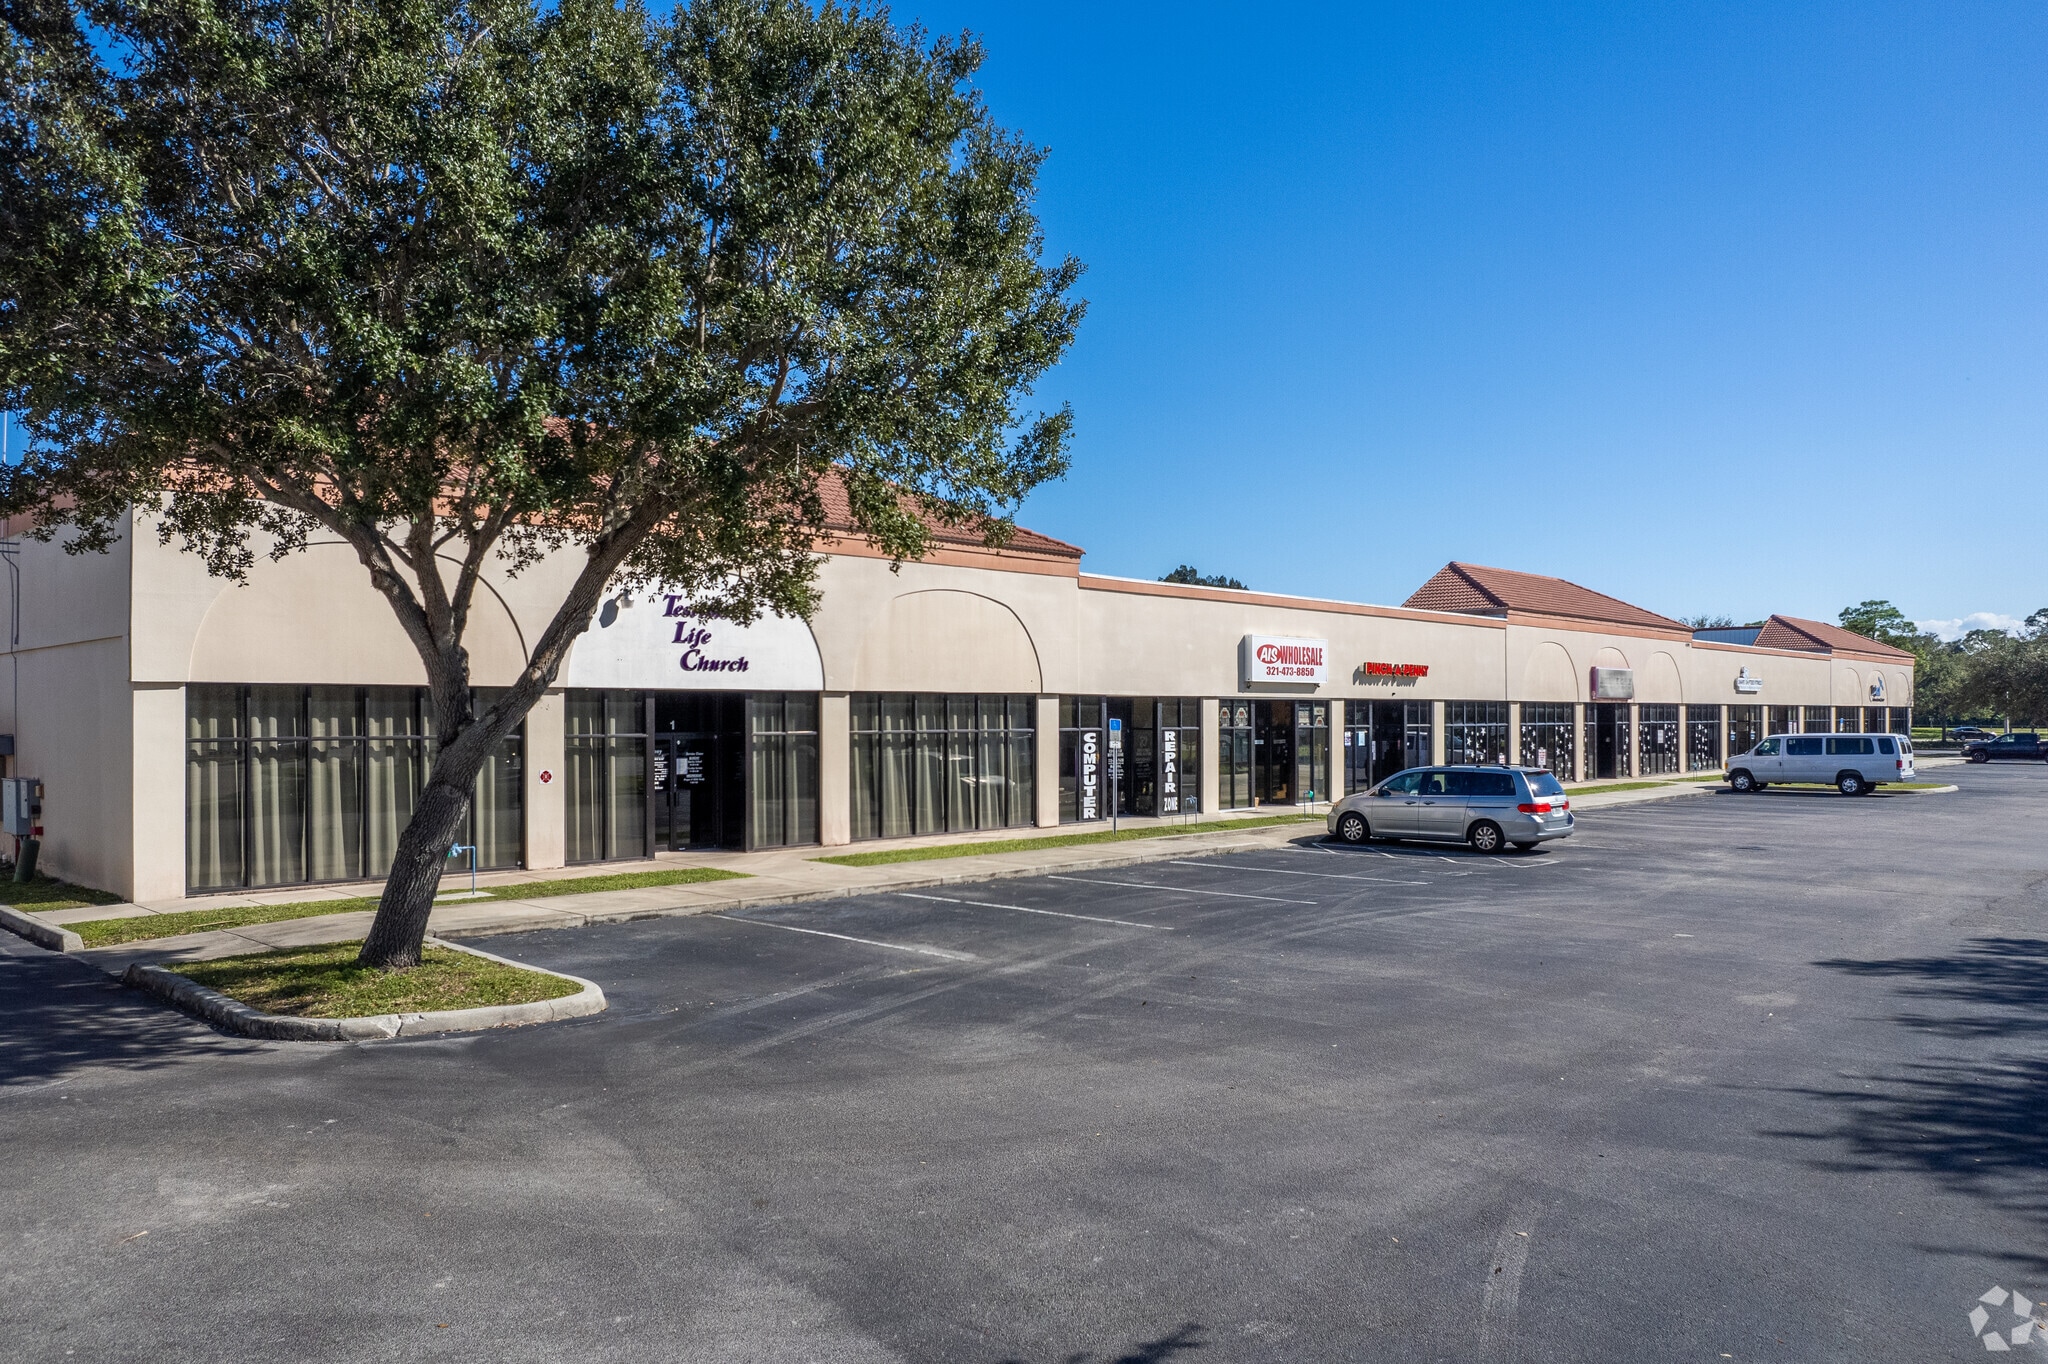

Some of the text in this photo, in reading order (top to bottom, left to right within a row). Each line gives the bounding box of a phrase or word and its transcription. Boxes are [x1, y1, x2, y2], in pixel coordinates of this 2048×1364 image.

[672, 621, 712, 649] Life
[680, 649, 749, 672] Church
[1260, 645, 1323, 666] AIS WHOLESALE
[1266, 666, 1315, 677] 321-473-8850
[670, 720, 675, 730] 1
[1164, 731, 1176, 793] REPAIR
[1083, 732, 1097, 819] COMPUTER
[1163, 797, 1178, 812] ZONE
